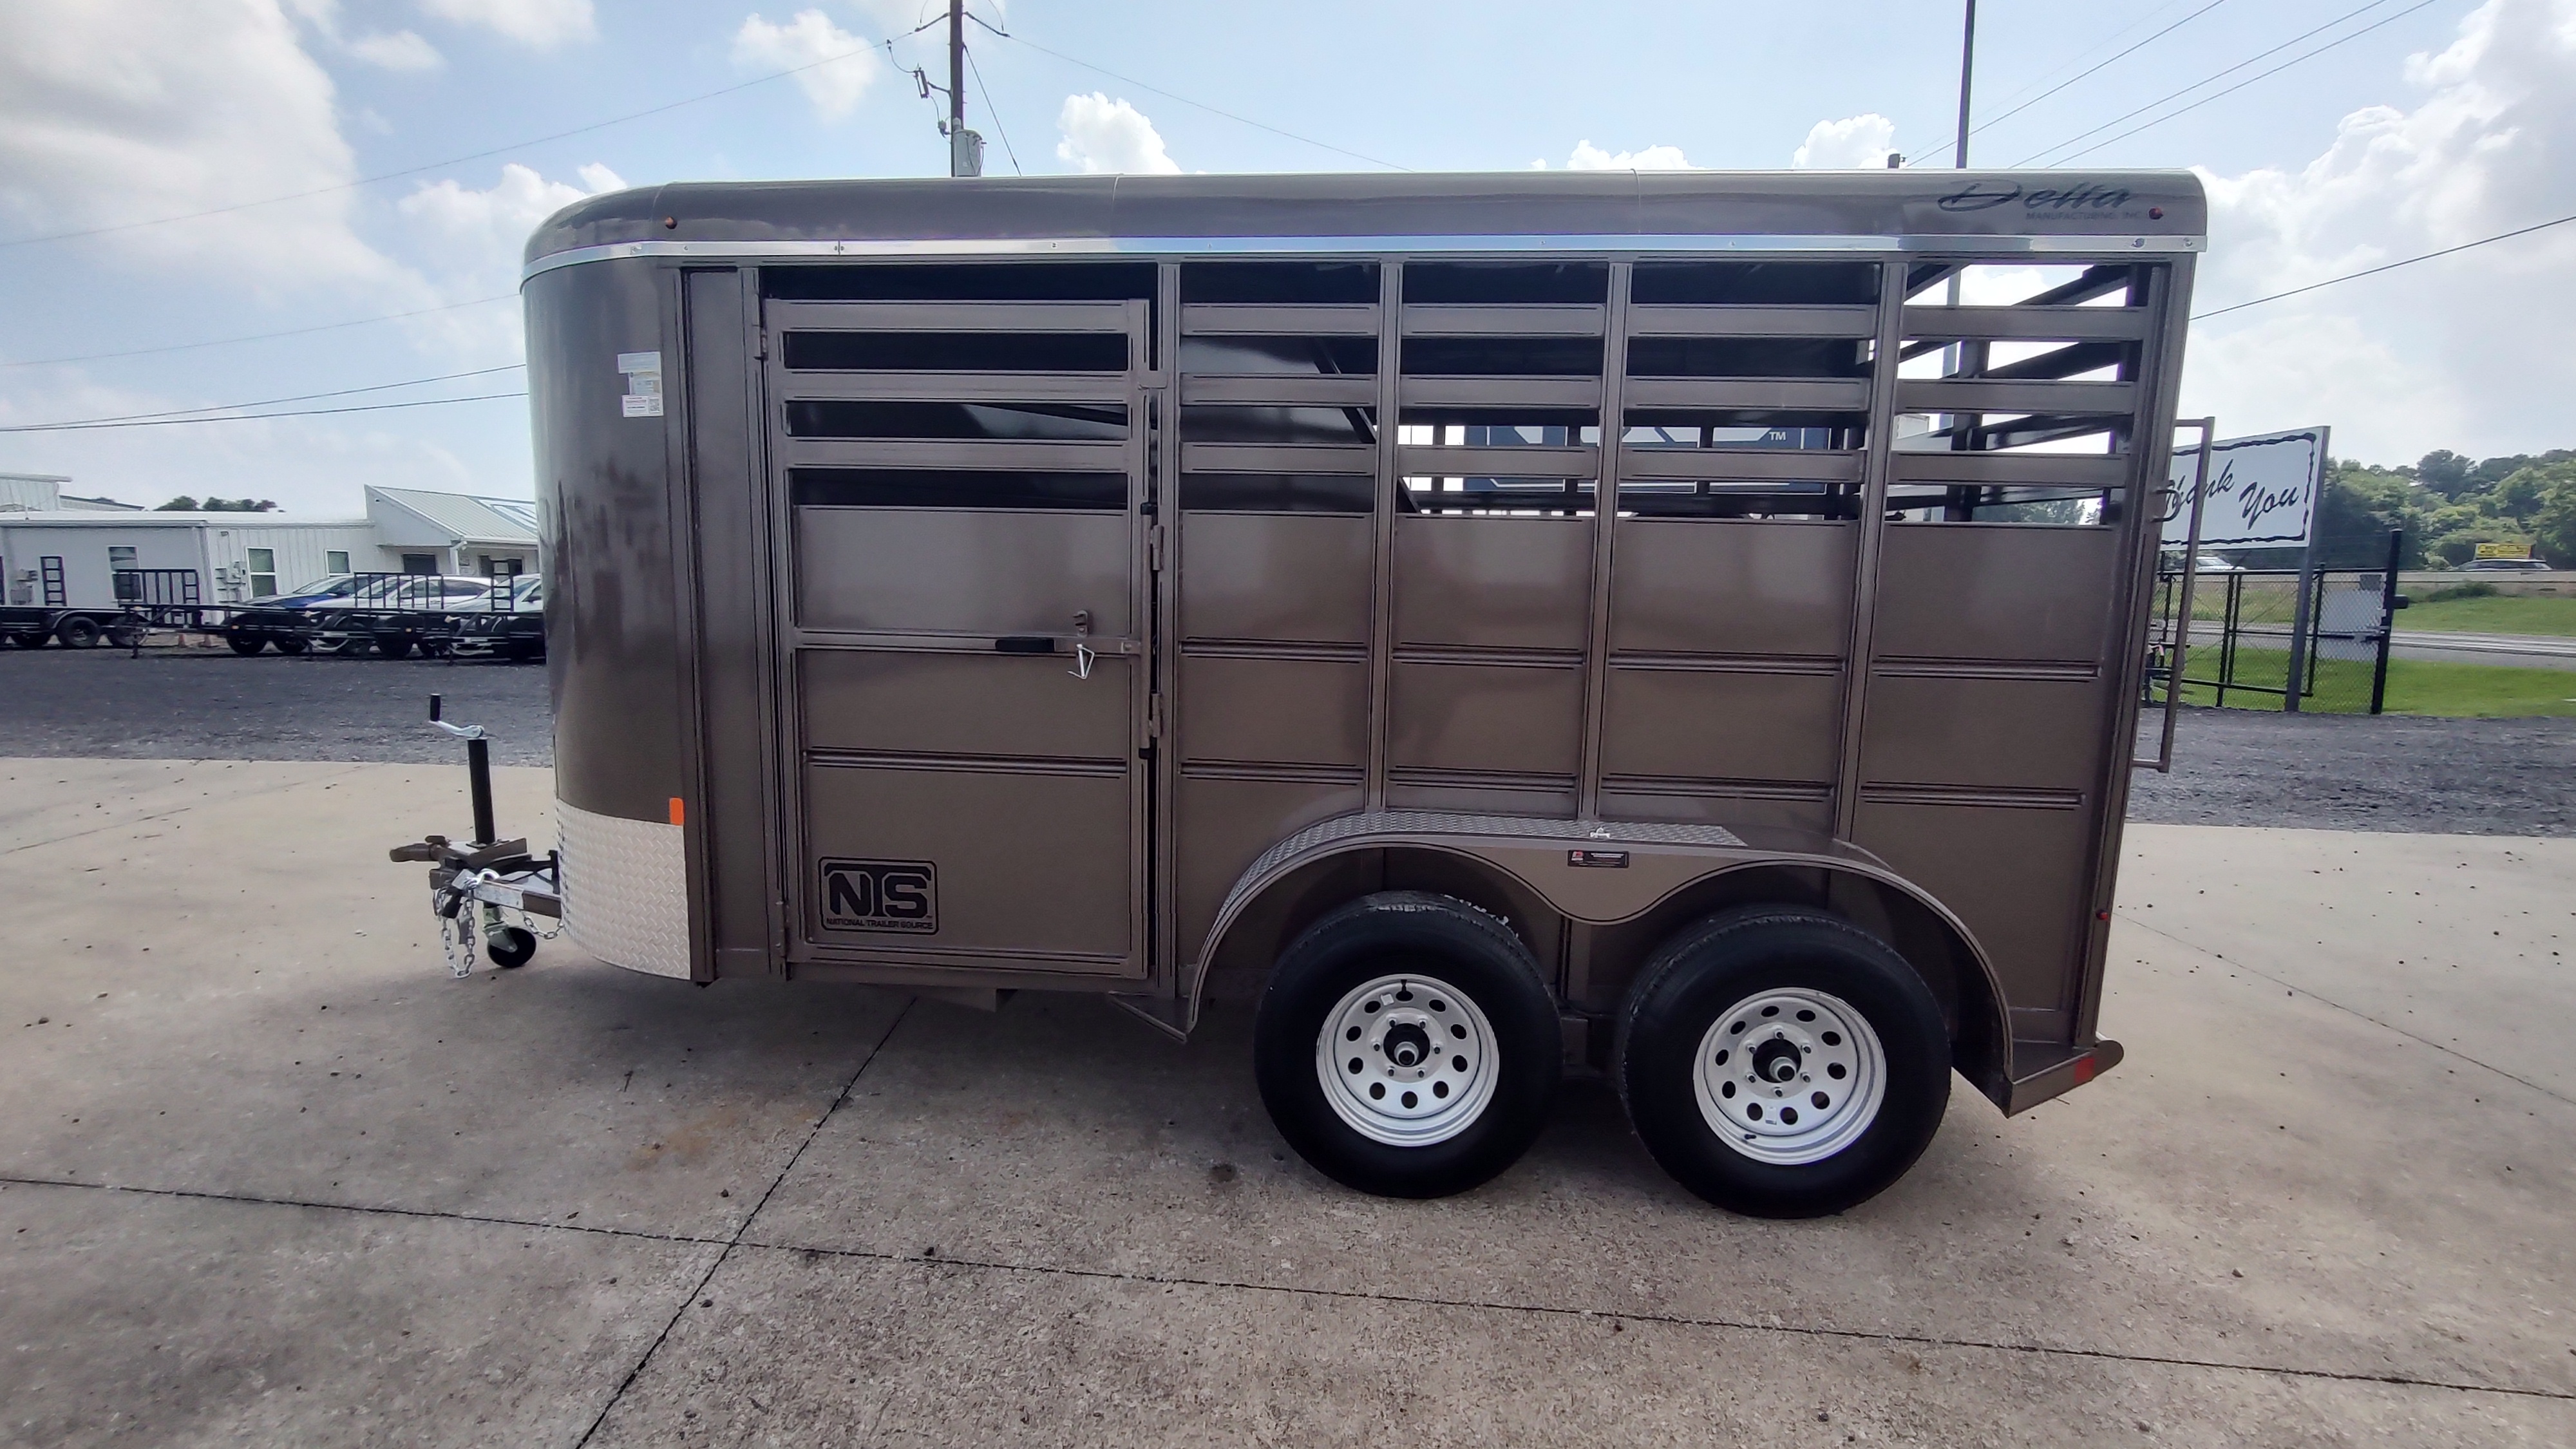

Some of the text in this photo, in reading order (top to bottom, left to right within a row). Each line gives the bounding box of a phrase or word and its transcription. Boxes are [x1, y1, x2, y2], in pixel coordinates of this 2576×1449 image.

[1768, 431, 1786, 440] TM
[2239, 482, 2299, 531] You
[826, 918, 933, 930] NATIONAL TRAILER SOURCE
